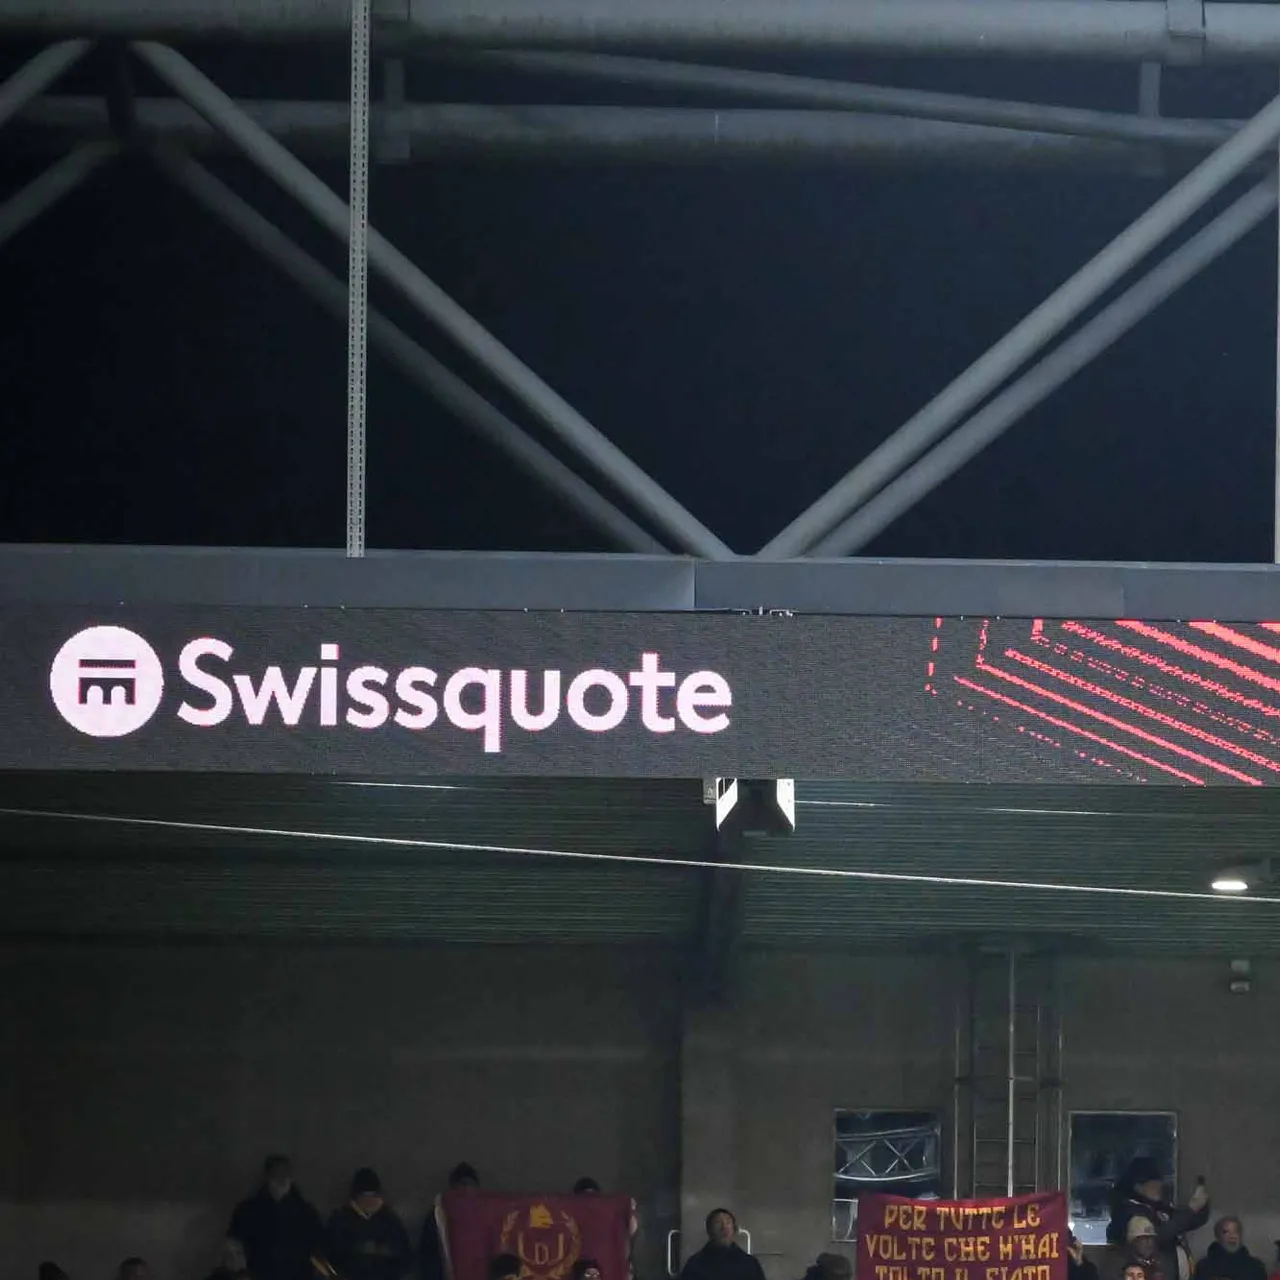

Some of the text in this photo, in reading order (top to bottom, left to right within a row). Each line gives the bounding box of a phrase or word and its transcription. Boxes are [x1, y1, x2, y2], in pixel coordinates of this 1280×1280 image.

[177, 637, 732, 752] Swissquote
[884, 1204, 1041, 1231] PER TUTTE LE
[865, 1231, 1060, 1262] VOLTE CHE M'HAI
